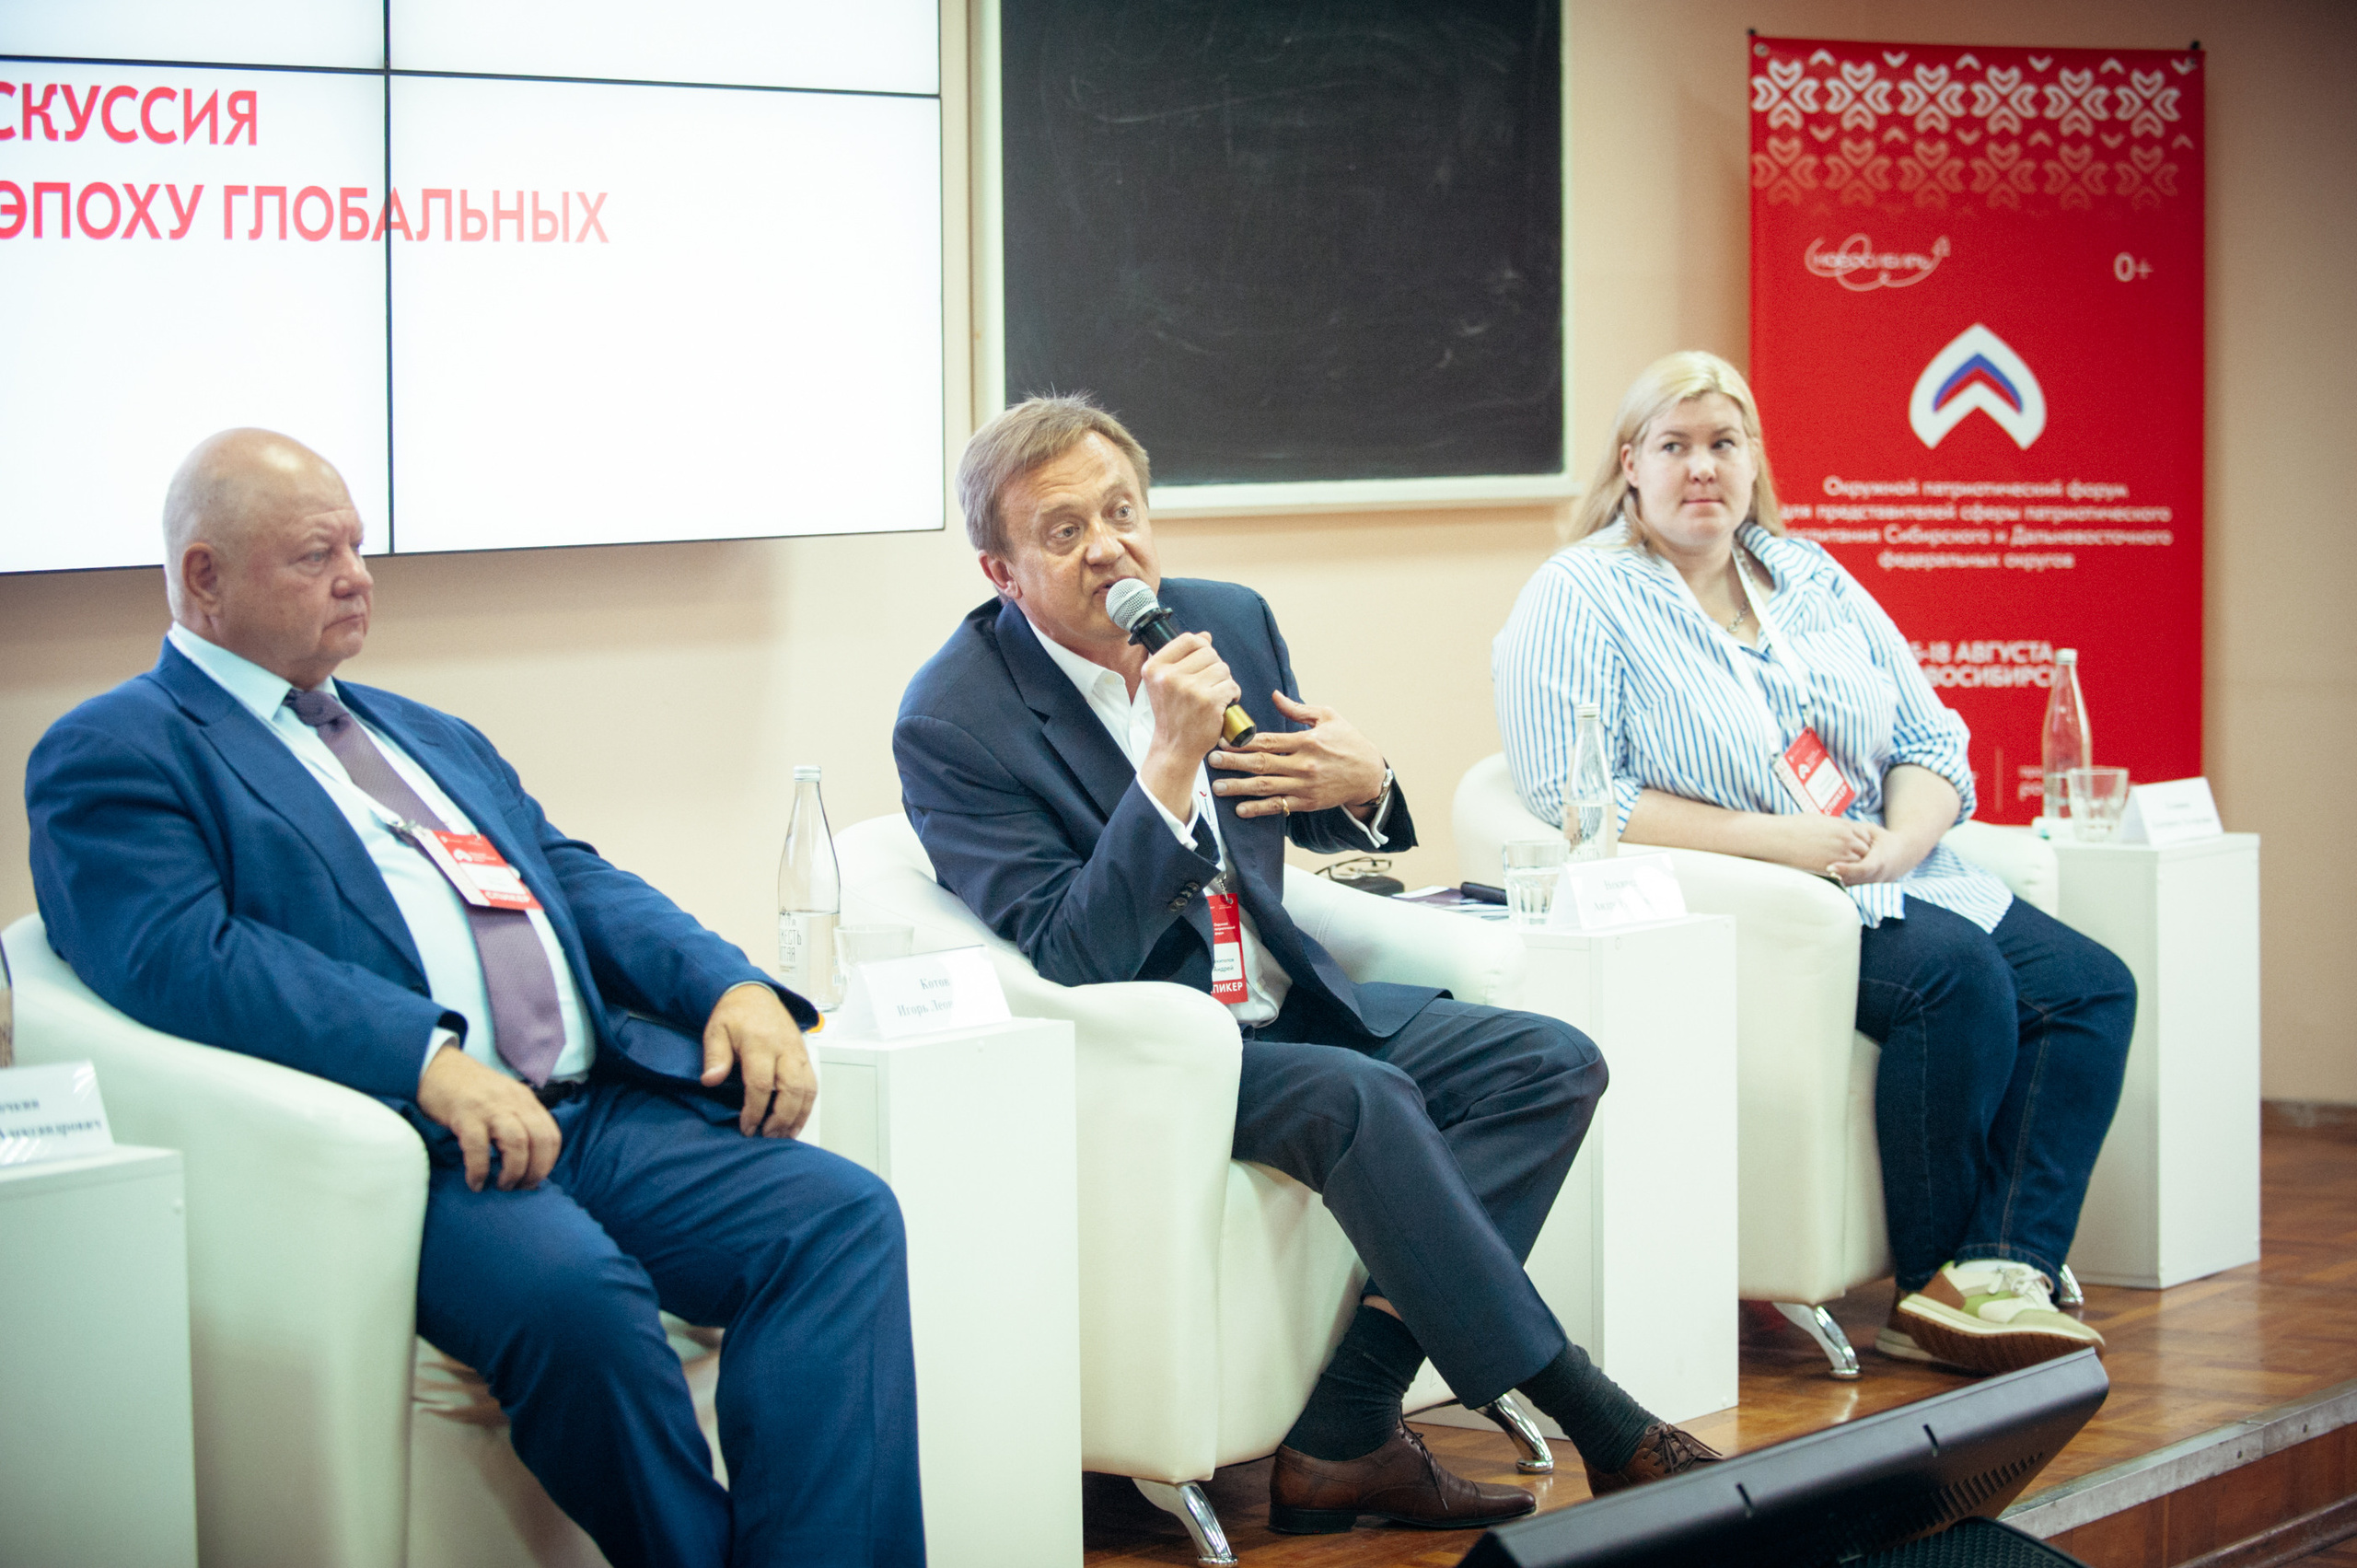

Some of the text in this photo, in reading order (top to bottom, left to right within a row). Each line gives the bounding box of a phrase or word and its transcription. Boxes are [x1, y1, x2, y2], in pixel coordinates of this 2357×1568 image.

[0, 180, 610, 244] ЭПОХУ ГЛОБАЛЬНЫХ
[1954, 640, 2054, 664] АВГУСТА
[920, 978, 950, 990] Котов
[1210, 981, 1243, 994] ПИКЕР
[896, 1003, 929, 1017] Игорь
